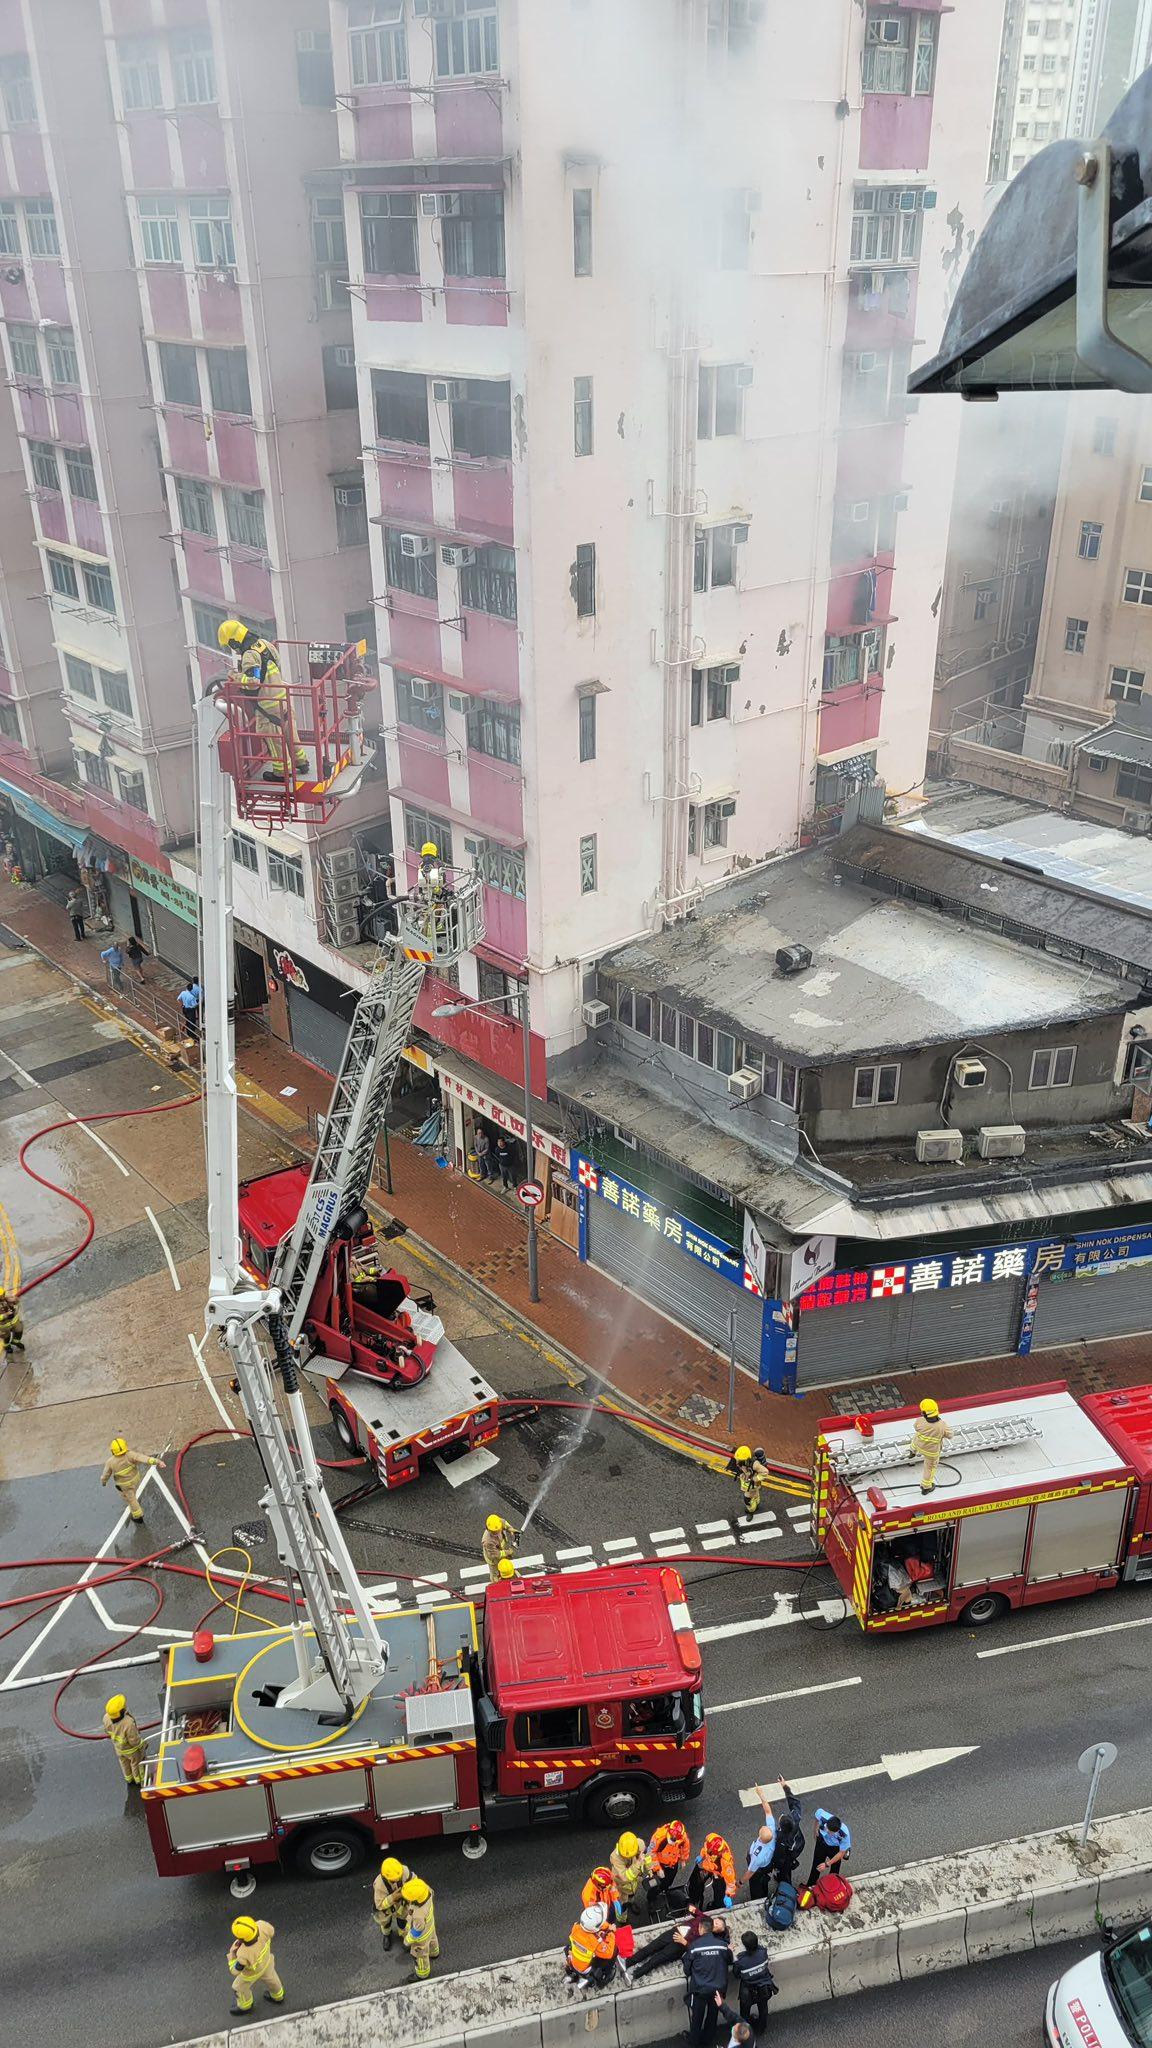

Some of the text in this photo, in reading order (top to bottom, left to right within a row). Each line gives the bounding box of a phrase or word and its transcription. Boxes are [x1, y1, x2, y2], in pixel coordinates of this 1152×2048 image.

[318, 1190, 338, 1239] MAGIRUS
[602, 1176, 683, 1245] 善諾藥房
[685, 1240, 720, 1268] 有限公司
[1074, 1245, 1130, 1264] 有限公司
[1075, 1240, 1095, 1250] SHIN
[1095, 1237, 1113, 1247] NOK
[909, 1243, 1066, 1293] 善諾藥房
[927, 1512, 947, 1521] ROAD
[961, 1503, 995, 1516] RAILWAY
